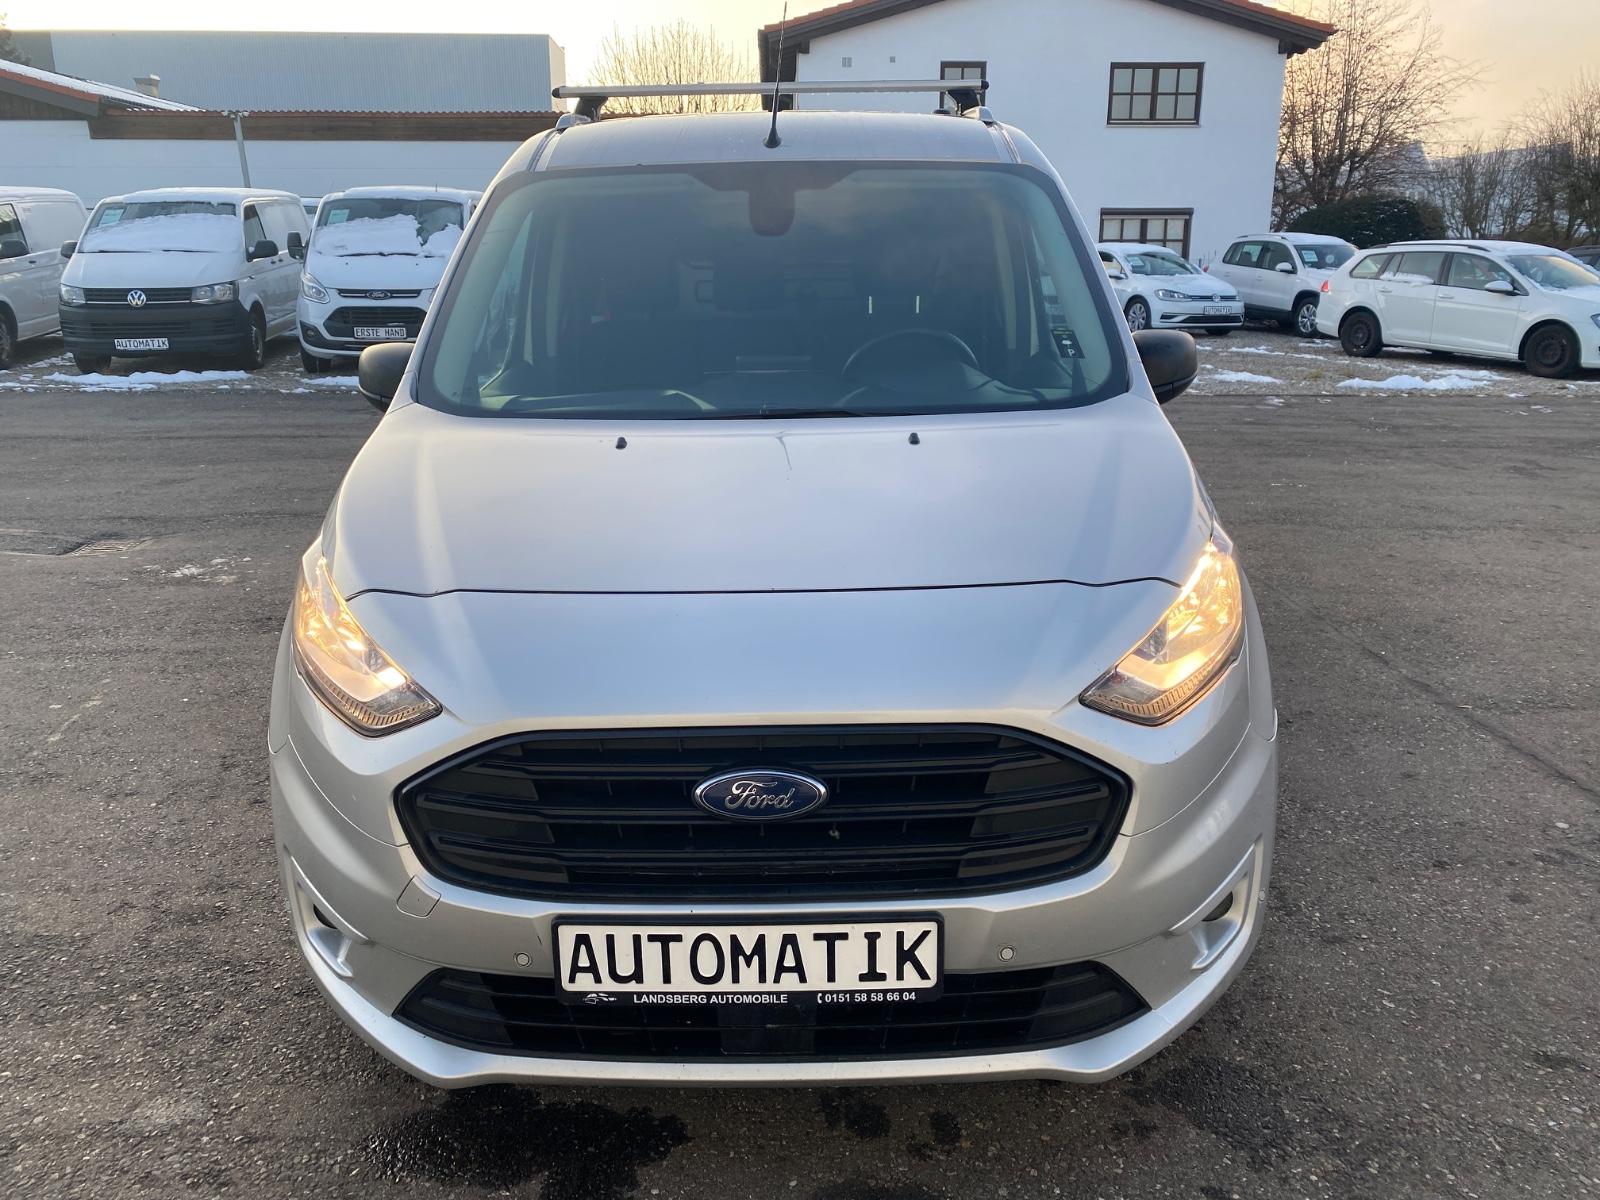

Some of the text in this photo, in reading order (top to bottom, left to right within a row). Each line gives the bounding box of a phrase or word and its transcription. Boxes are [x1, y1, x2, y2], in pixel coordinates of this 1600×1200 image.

[355, 328, 405, 337] ERSTE HAND
[116, 339, 168, 349] AUTOMATIK
[725, 780, 795, 809] Ford
[567, 929, 932, 985] AUTOMATIK
[633, 994, 788, 1004] LANDSBERG AUTOMOBILE
[825, 991, 917, 1003] 0151 58 58 66 04
